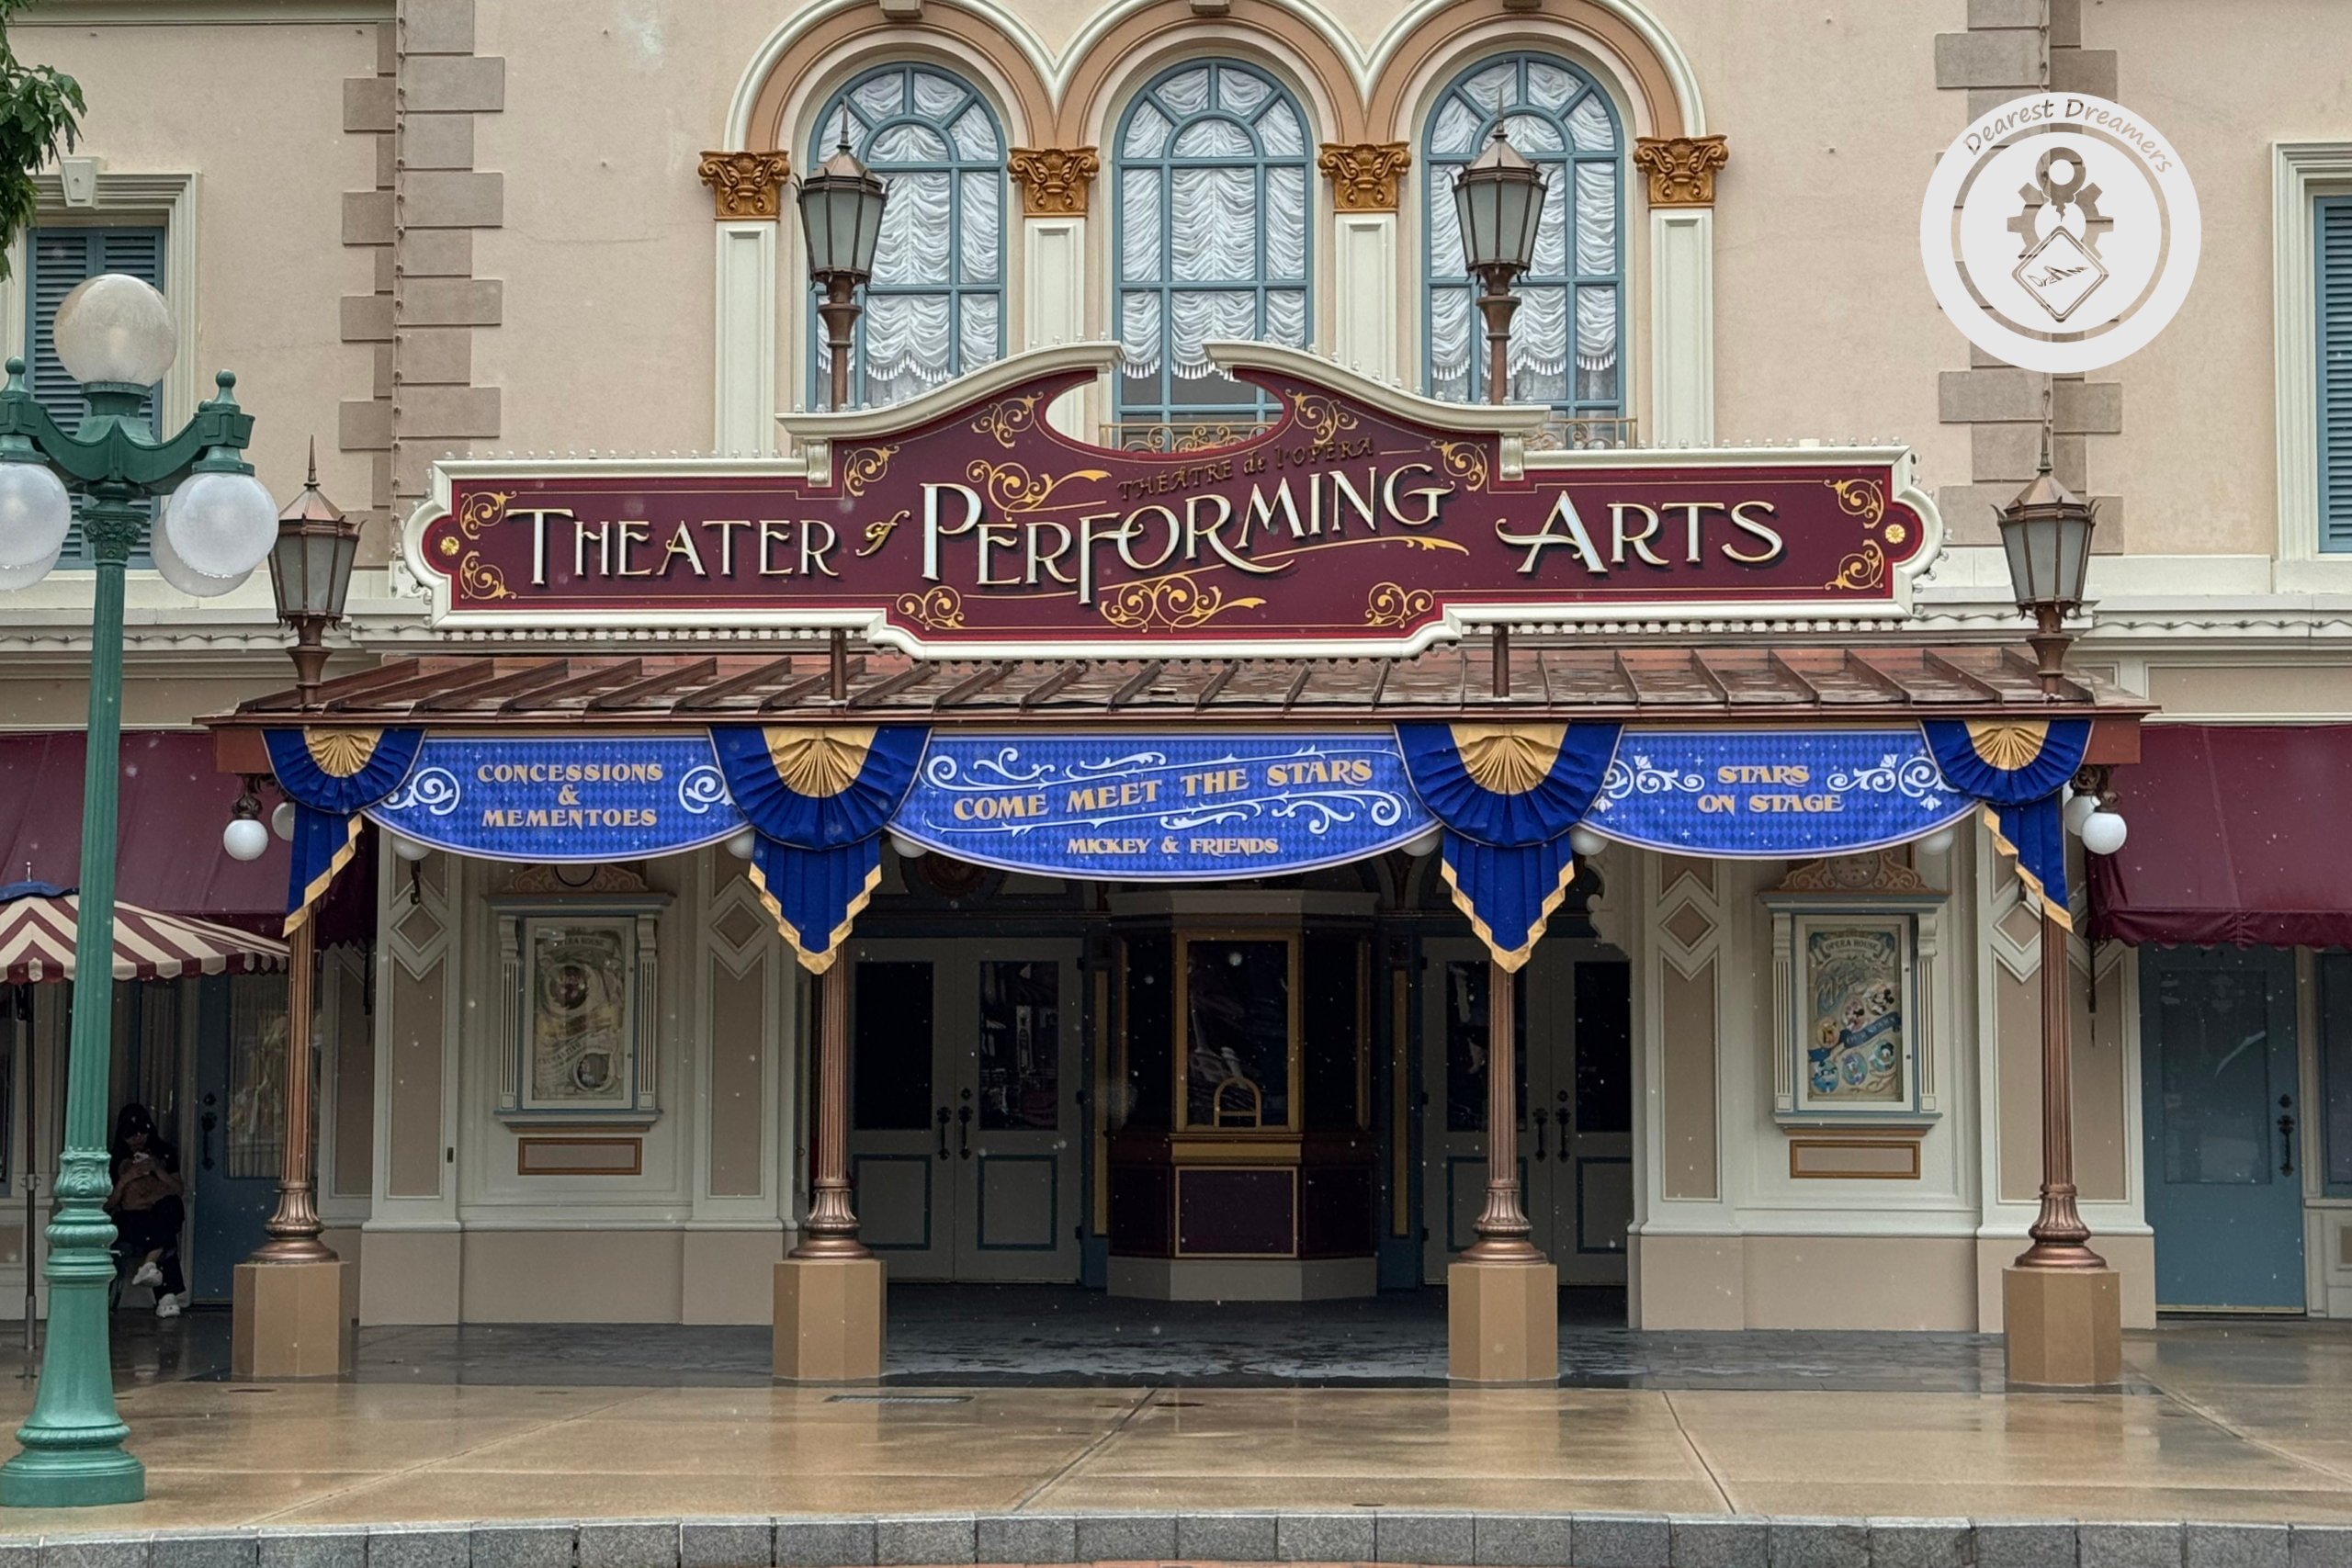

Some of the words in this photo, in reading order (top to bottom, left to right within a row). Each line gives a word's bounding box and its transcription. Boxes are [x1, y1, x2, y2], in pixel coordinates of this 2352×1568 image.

[1242, 451, 1266, 475] de
[505, 509, 839, 585] THEATER
[920, 464, 1456, 605] PERFORMING
[1495, 490, 1782, 574] ARTS
[477, 763, 663, 785] CONCESSIONS
[1717, 765, 1810, 787] STARS
[558, 784, 581, 806] &
[954, 794, 1049, 821] COME
[1066, 779, 1162, 814] MEET
[1180, 768, 1250, 796] THE
[1266, 759, 1372, 787] STARS
[1698, 795, 1735, 816] ON
[1749, 794, 1846, 813] STAGE
[481, 808, 657, 830] MEMENTOES
[1066, 838, 1151, 854] MICKEY
[1160, 837, 1180, 854] &
[1190, 837, 1279, 858] FRIENDS
[1825, 939, 1851, 951] OPERA
[1853, 939, 1880, 952] HOUSE
